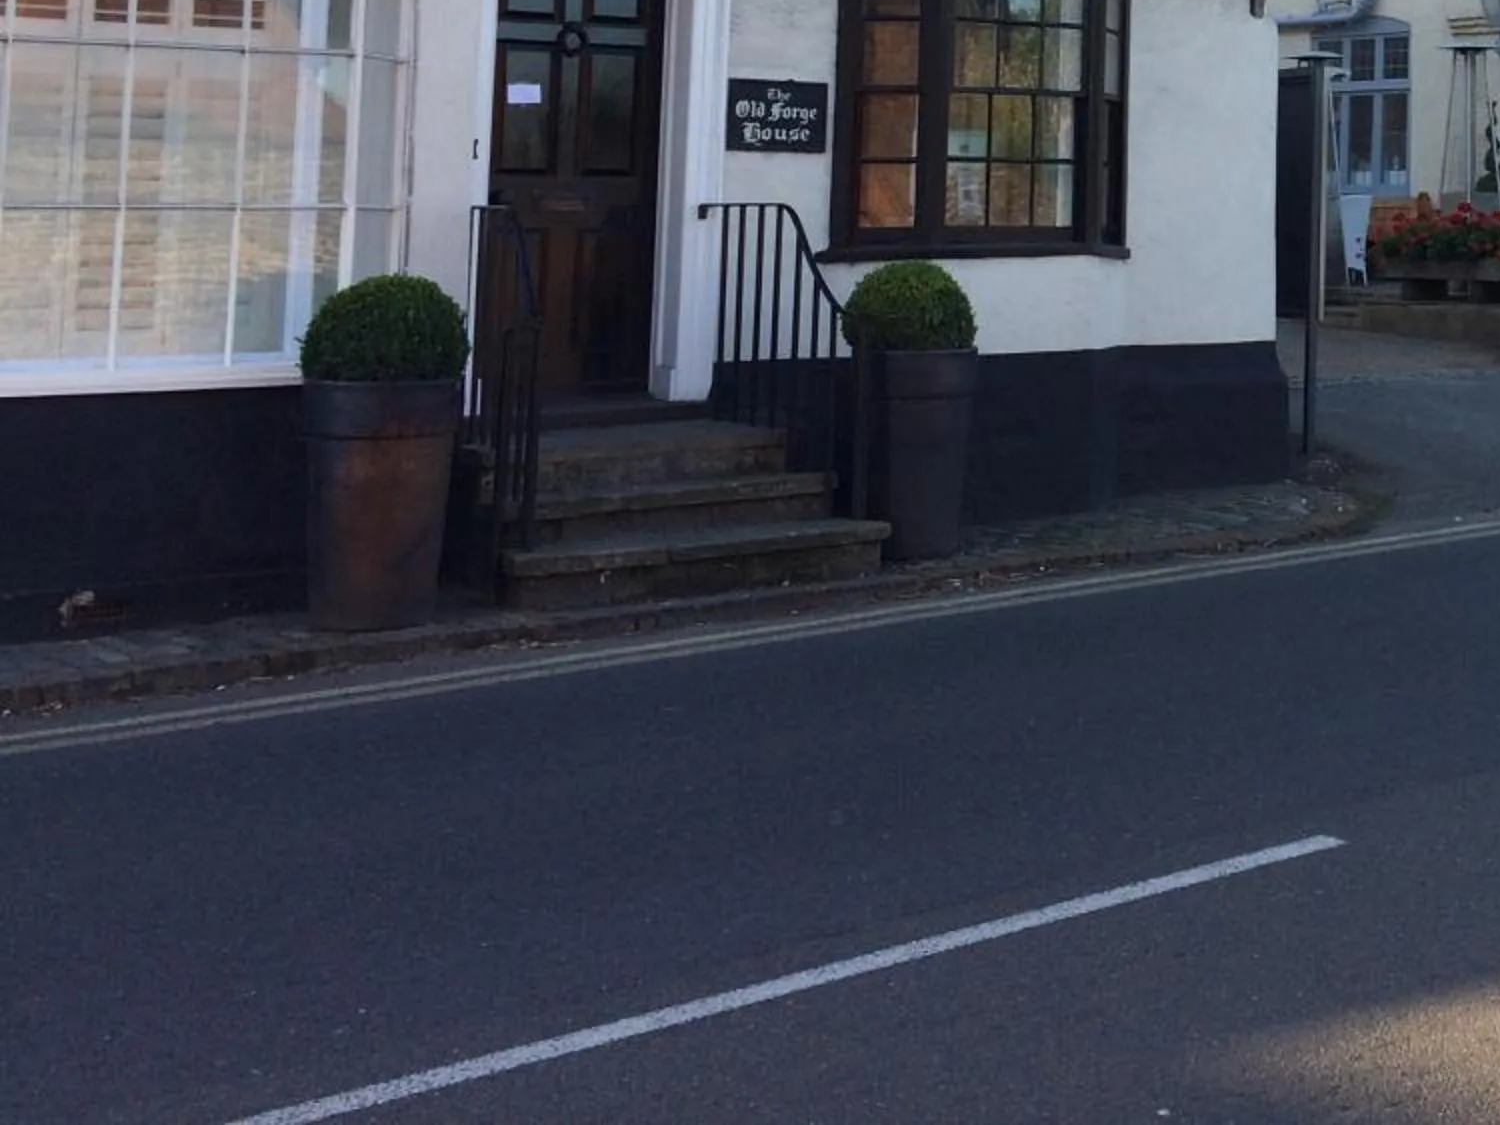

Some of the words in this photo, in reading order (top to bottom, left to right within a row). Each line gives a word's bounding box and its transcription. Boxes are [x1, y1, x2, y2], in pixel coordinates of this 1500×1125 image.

[766, 87, 792, 101] The
[735, 100, 765, 118] Old
[768, 102, 818, 125] Forge
[741, 121, 811, 145] House
